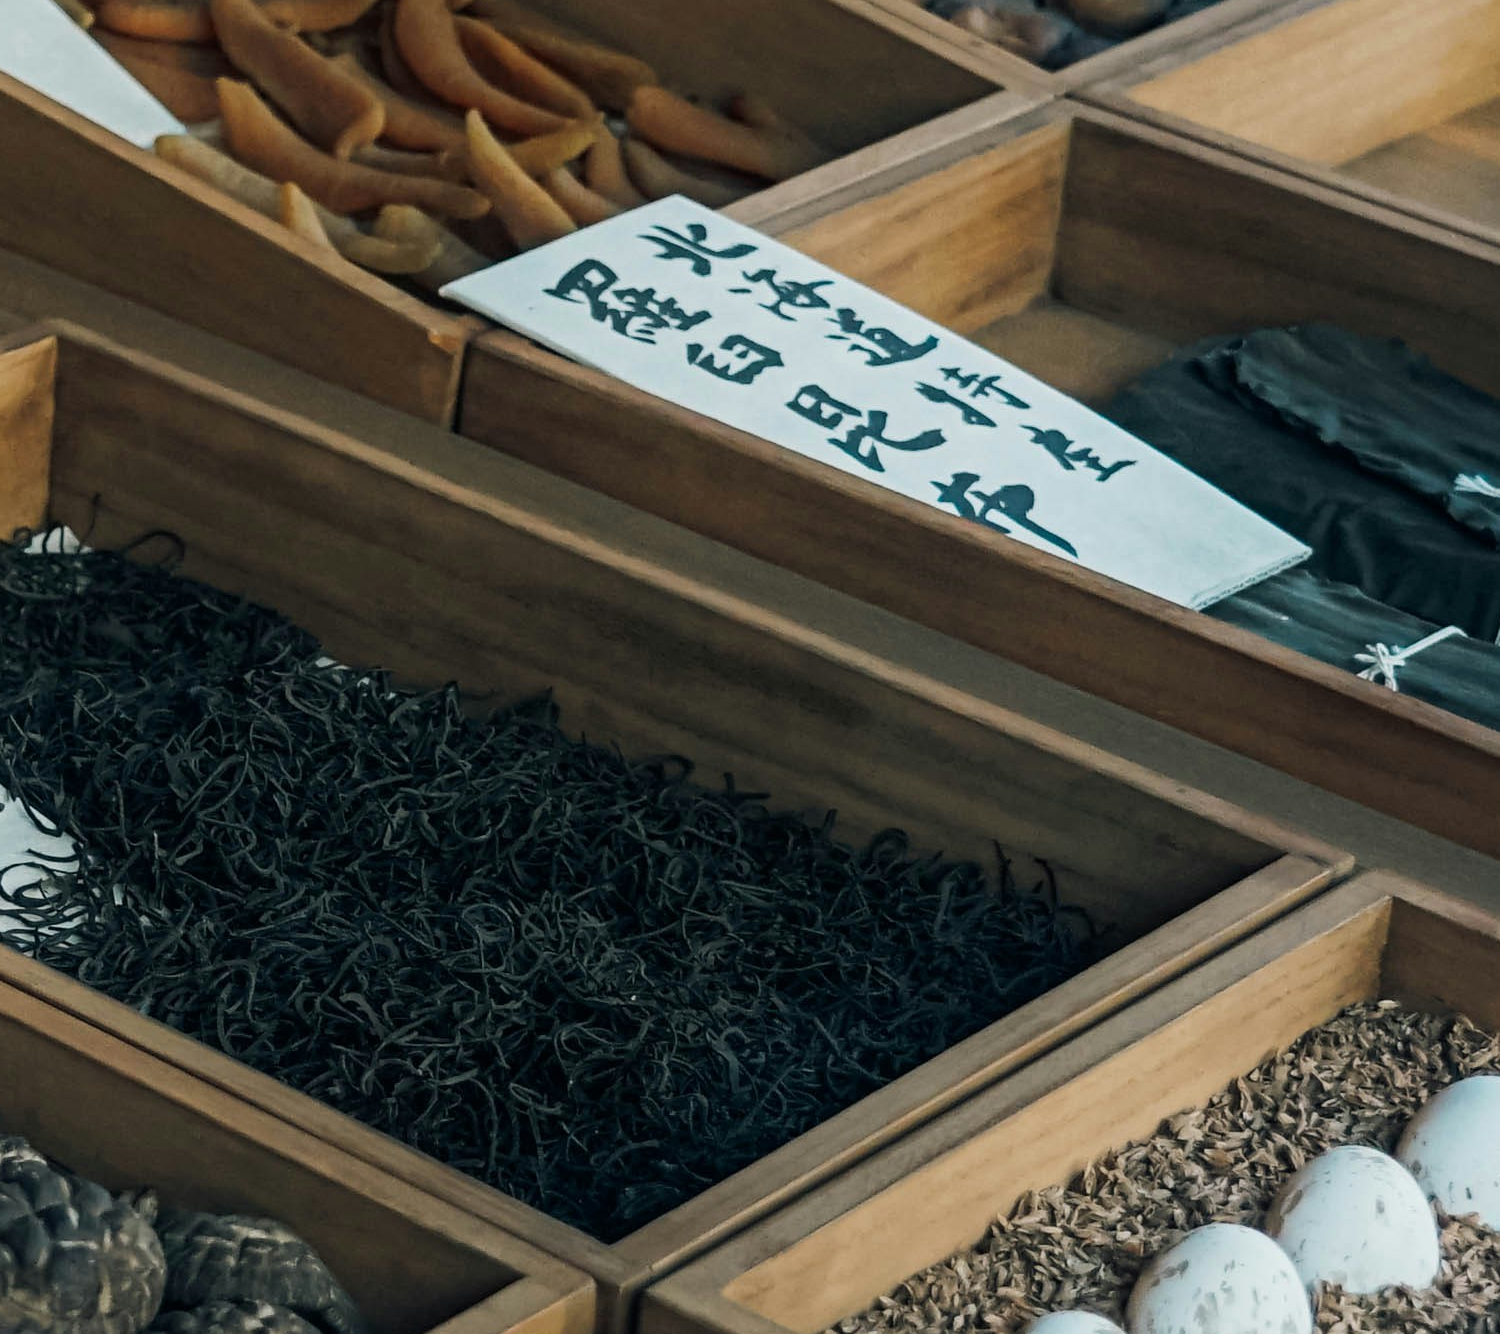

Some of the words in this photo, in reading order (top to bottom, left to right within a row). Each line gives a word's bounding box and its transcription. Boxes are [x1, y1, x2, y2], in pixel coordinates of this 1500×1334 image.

[640, 223, 1136, 482] 北海道特産
